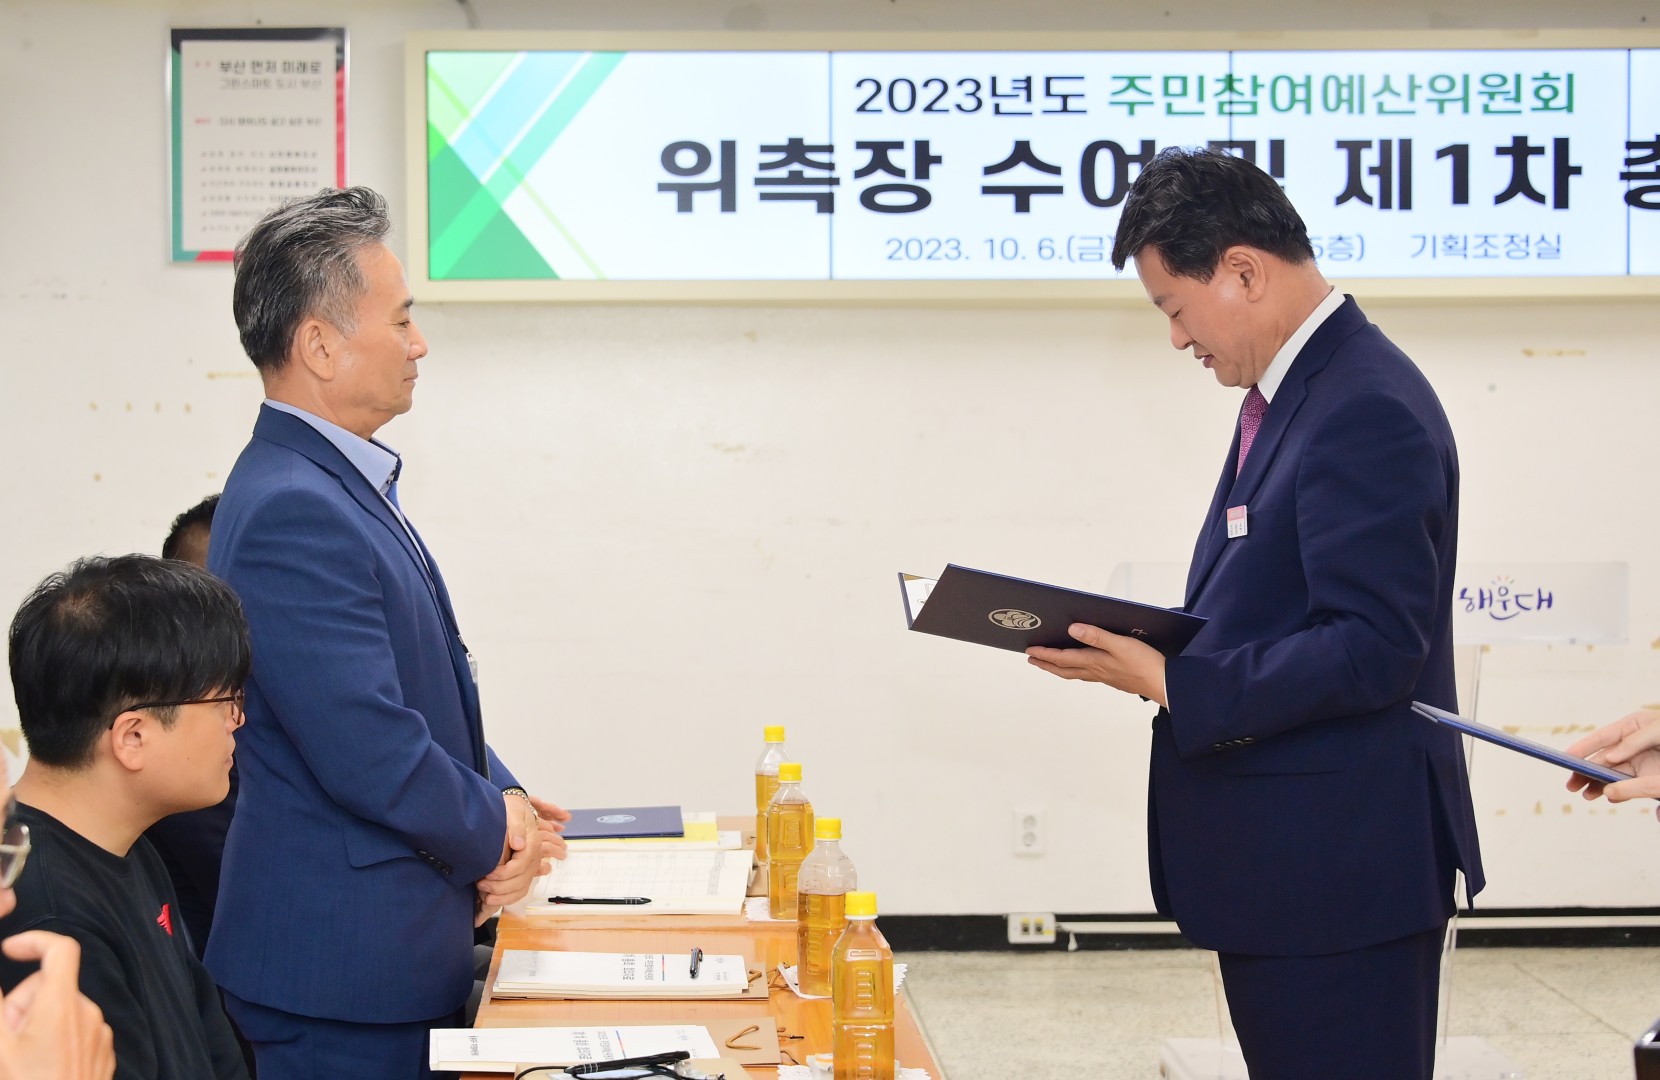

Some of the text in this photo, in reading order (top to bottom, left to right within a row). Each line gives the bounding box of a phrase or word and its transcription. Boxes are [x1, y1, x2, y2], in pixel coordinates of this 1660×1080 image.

[219, 60, 246, 75] 부산
[854, 72, 1577, 116] 2023년도 주민참여예산위원회
[656, 137, 943, 214] 위촉장
[1334, 134, 1583, 211] 제1차
[886, 237, 970, 261] 2023.
[984, 237, 1026, 261] 10.
[1411, 233, 1562, 261] 기획조정실
[1459, 585, 1553, 620] 해운대
